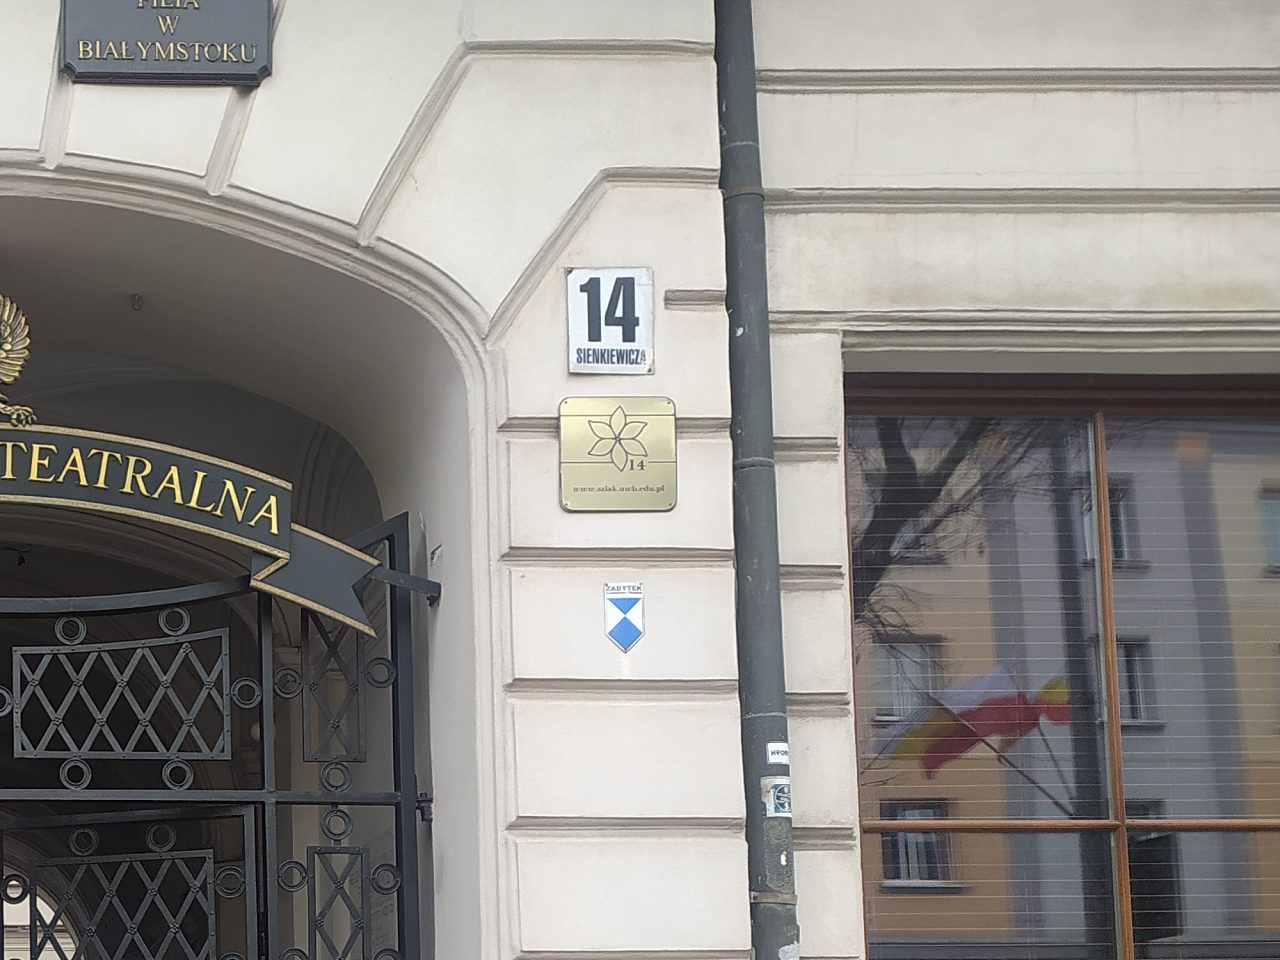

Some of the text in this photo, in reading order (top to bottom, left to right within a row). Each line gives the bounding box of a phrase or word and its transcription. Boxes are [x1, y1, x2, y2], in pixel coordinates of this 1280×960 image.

[157, 15, 180, 35] W
[77, 40, 258, 63] BIAŁYMSTOKU
[580, 277, 640, 343] 14
[628, 458, 646, 471] 14
